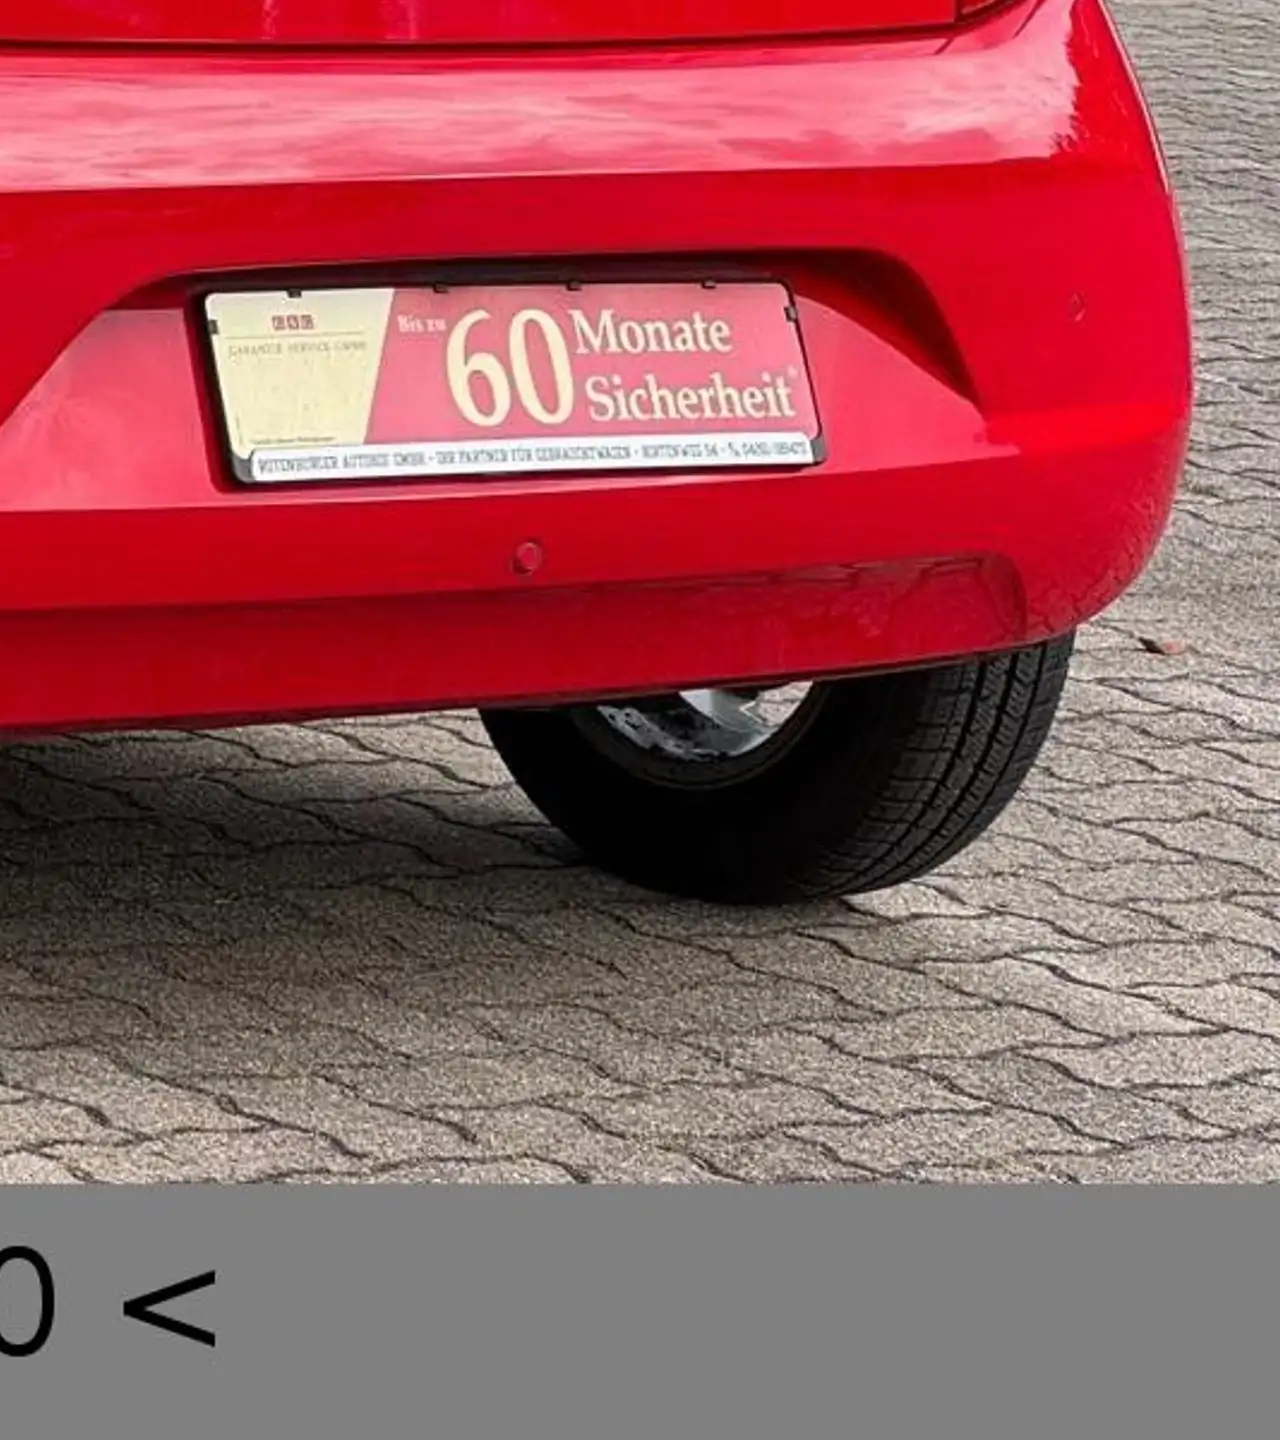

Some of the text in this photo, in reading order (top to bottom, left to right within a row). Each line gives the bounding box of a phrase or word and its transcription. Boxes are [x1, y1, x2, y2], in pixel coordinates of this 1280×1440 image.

[397, 313, 424, 333] Bis
[446, 309, 574, 427] 60
[567, 308, 733, 354] Monate
[585, 372, 796, 423] Sicherheit
